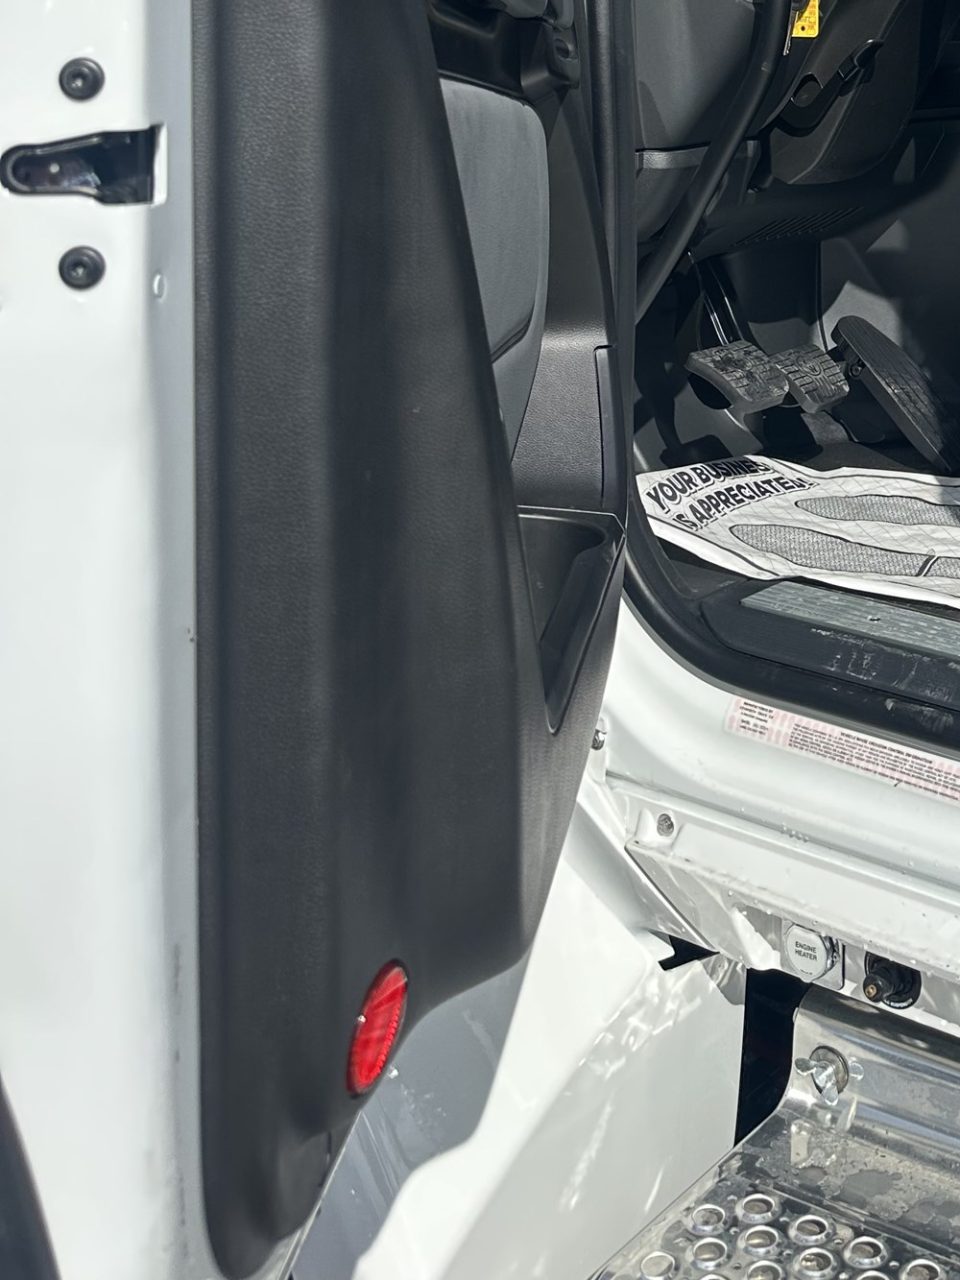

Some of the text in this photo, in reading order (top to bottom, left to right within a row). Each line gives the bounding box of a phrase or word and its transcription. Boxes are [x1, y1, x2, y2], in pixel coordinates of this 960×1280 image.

[646, 471, 699, 512] YOUR
[673, 513, 699, 531] IS
[795, 941, 817, 954] ENGINE
[795, 949, 818, 961] HEATER
